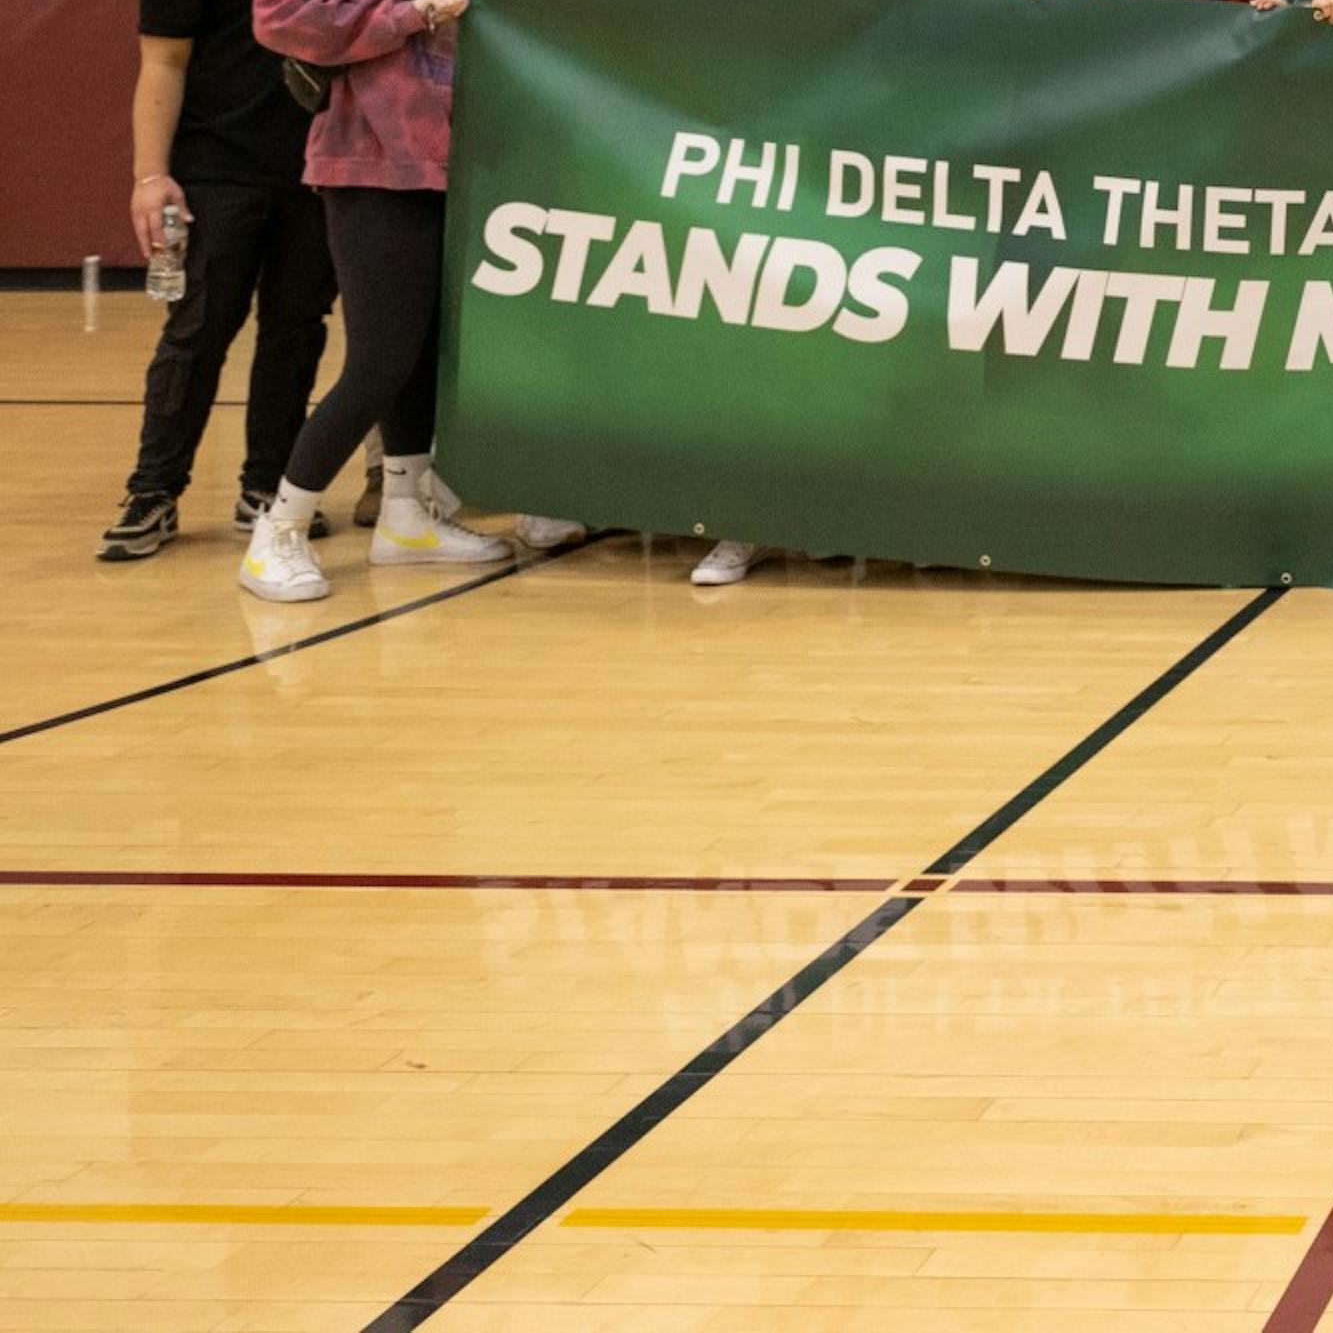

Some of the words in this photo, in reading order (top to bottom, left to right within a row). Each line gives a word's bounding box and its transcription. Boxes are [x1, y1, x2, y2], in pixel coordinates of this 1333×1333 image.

[661, 131, 799, 212] PHI
[826, 149, 1067, 242] DELTA
[473, 201, 923, 345] STANDS
[948, 257, 1269, 371] WITH
